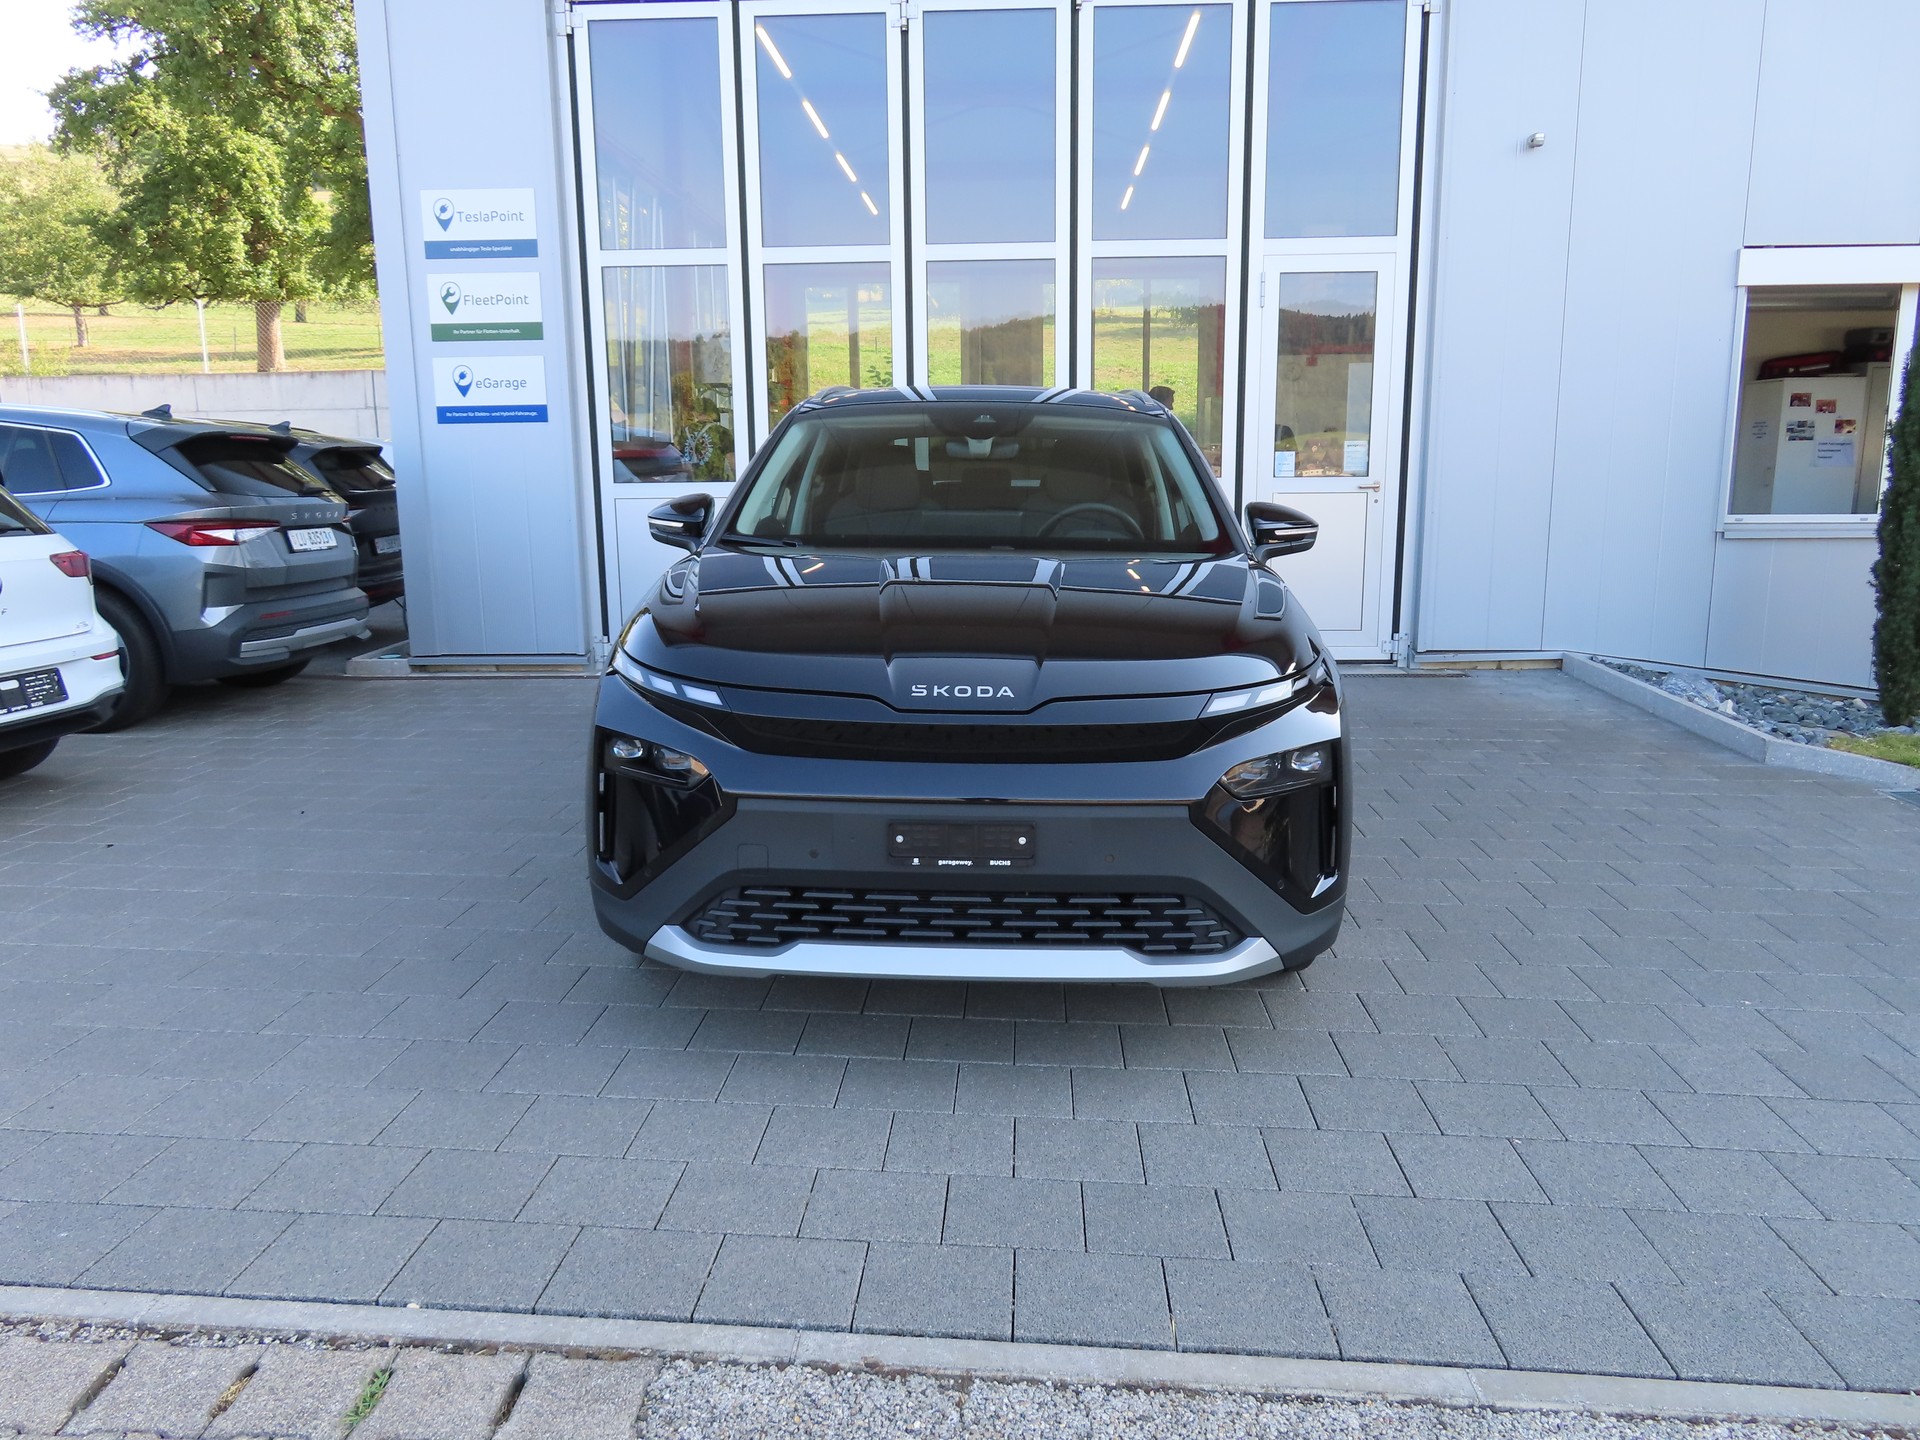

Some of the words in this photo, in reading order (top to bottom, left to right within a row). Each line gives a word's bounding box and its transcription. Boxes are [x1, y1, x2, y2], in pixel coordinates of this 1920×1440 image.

[456, 210, 525, 222] TeslaPoint
[463, 294, 529, 306] FleetPoint
[475, 377, 527, 391] eGarage
